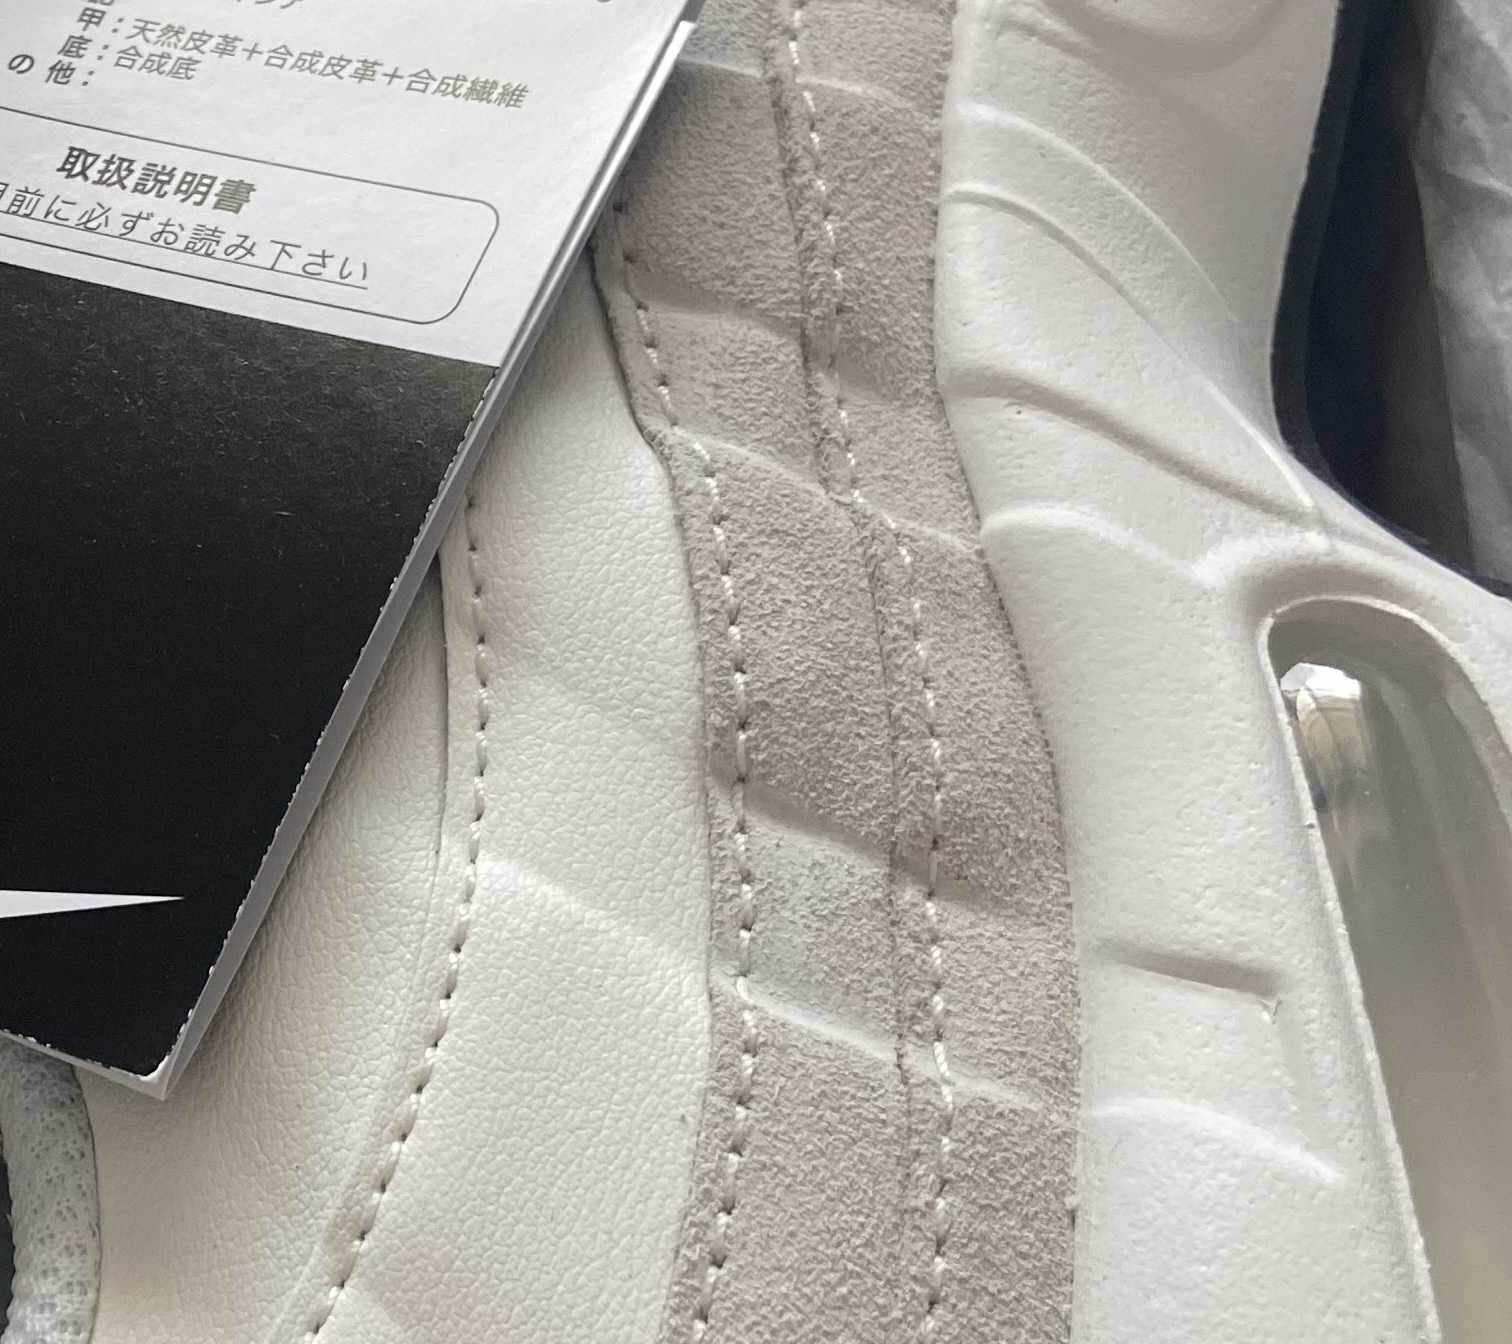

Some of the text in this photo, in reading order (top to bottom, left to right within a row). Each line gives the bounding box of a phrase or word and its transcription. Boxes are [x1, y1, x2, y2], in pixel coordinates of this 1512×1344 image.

[113, 45, 203, 81] 合成底
[56, 145, 257, 217] 取扱説明書
